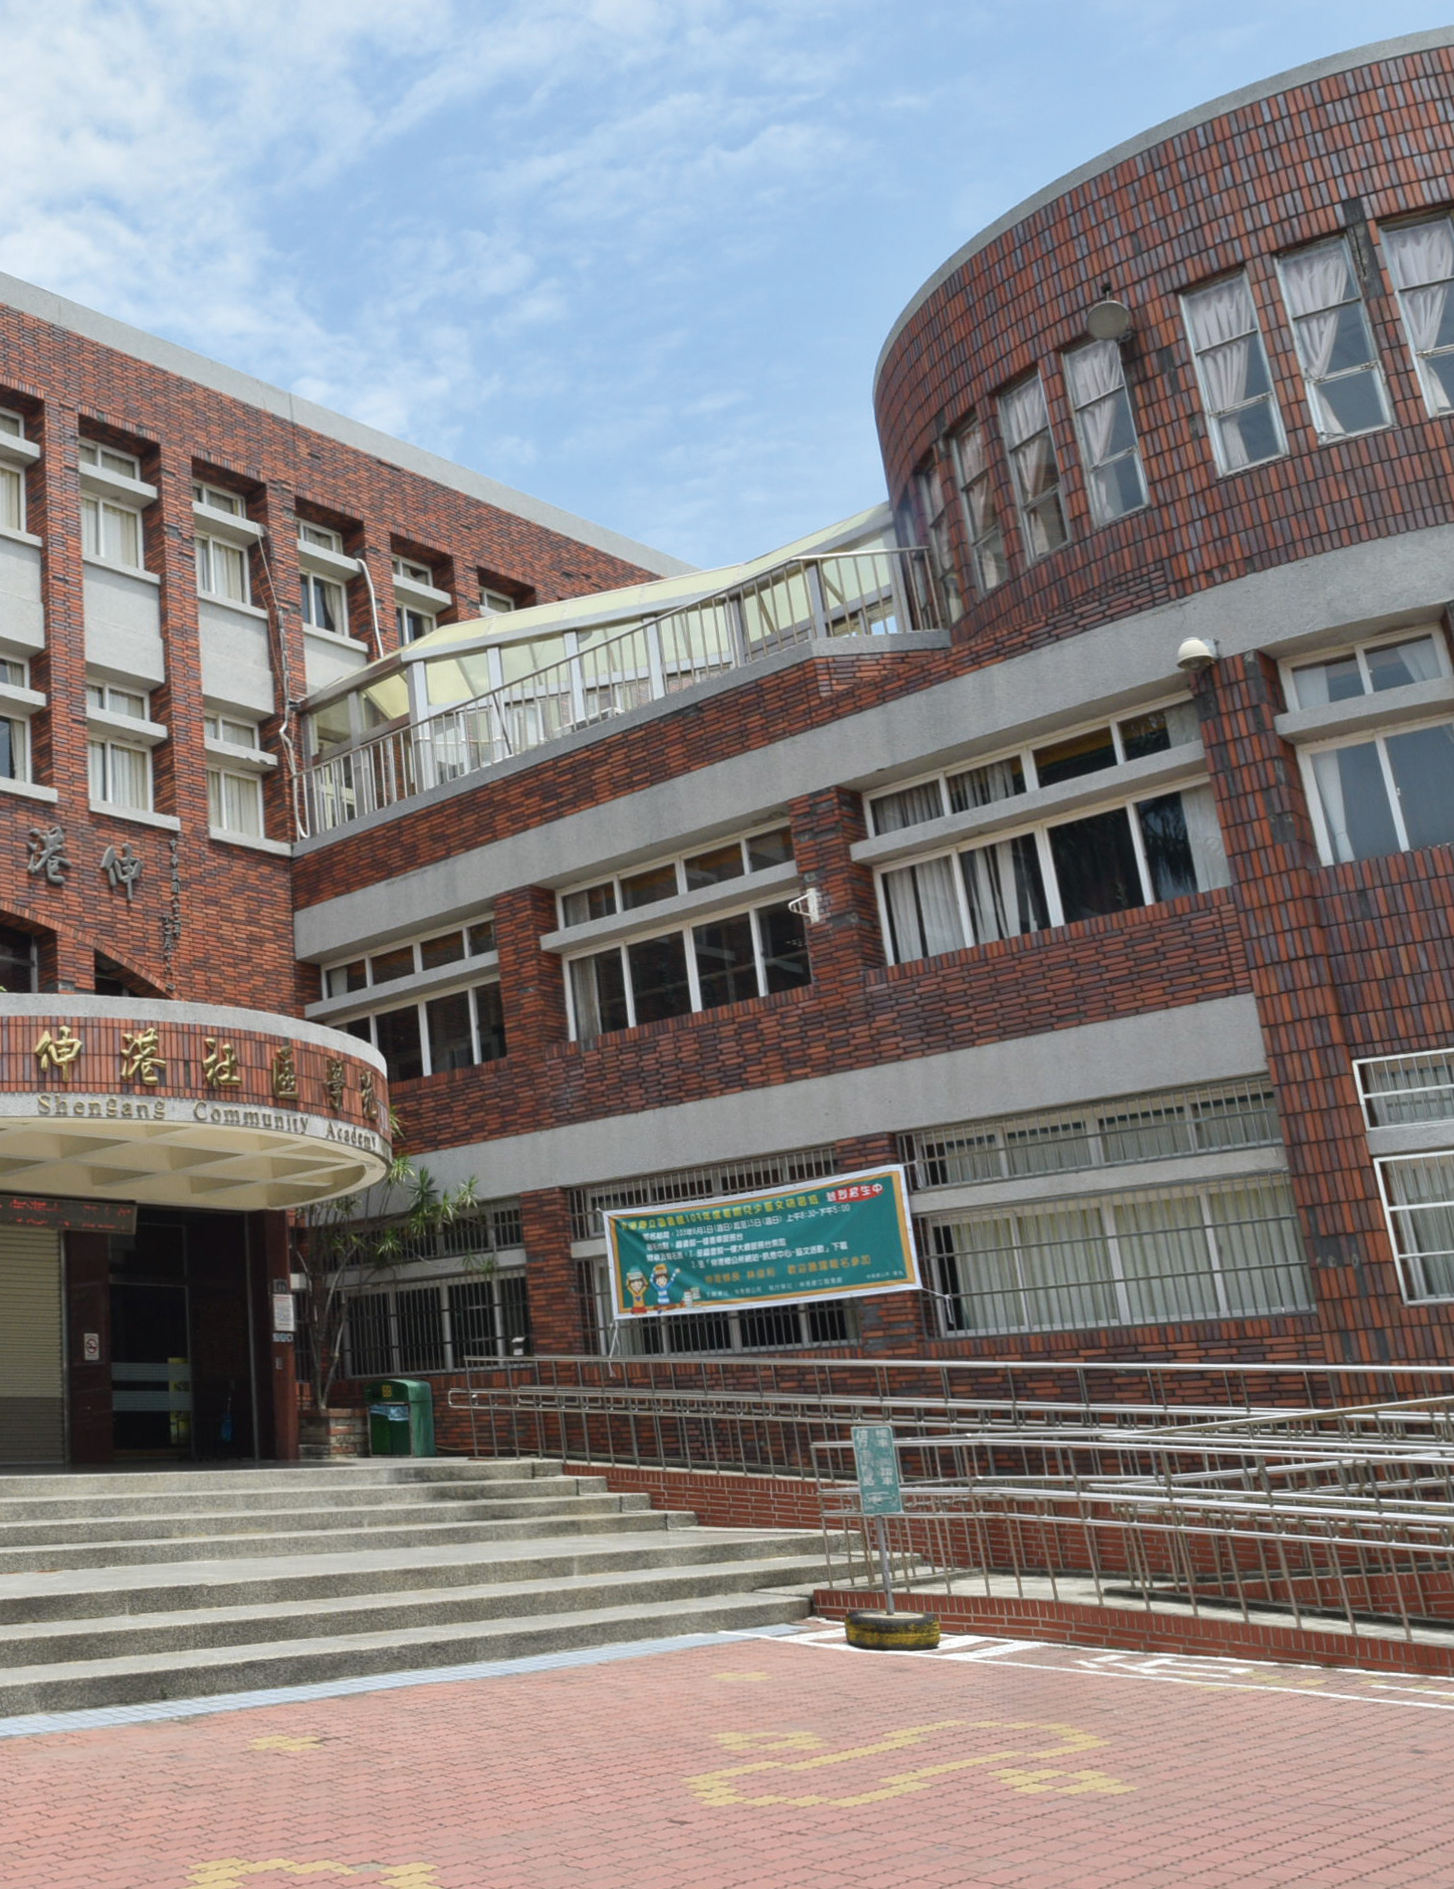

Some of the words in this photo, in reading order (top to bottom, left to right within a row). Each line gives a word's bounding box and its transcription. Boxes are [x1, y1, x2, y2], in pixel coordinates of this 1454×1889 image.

[38, 1093, 165, 1119] Shengang
[194, 1102, 309, 1135] Community
[326, 1121, 377, 1151] Academy
